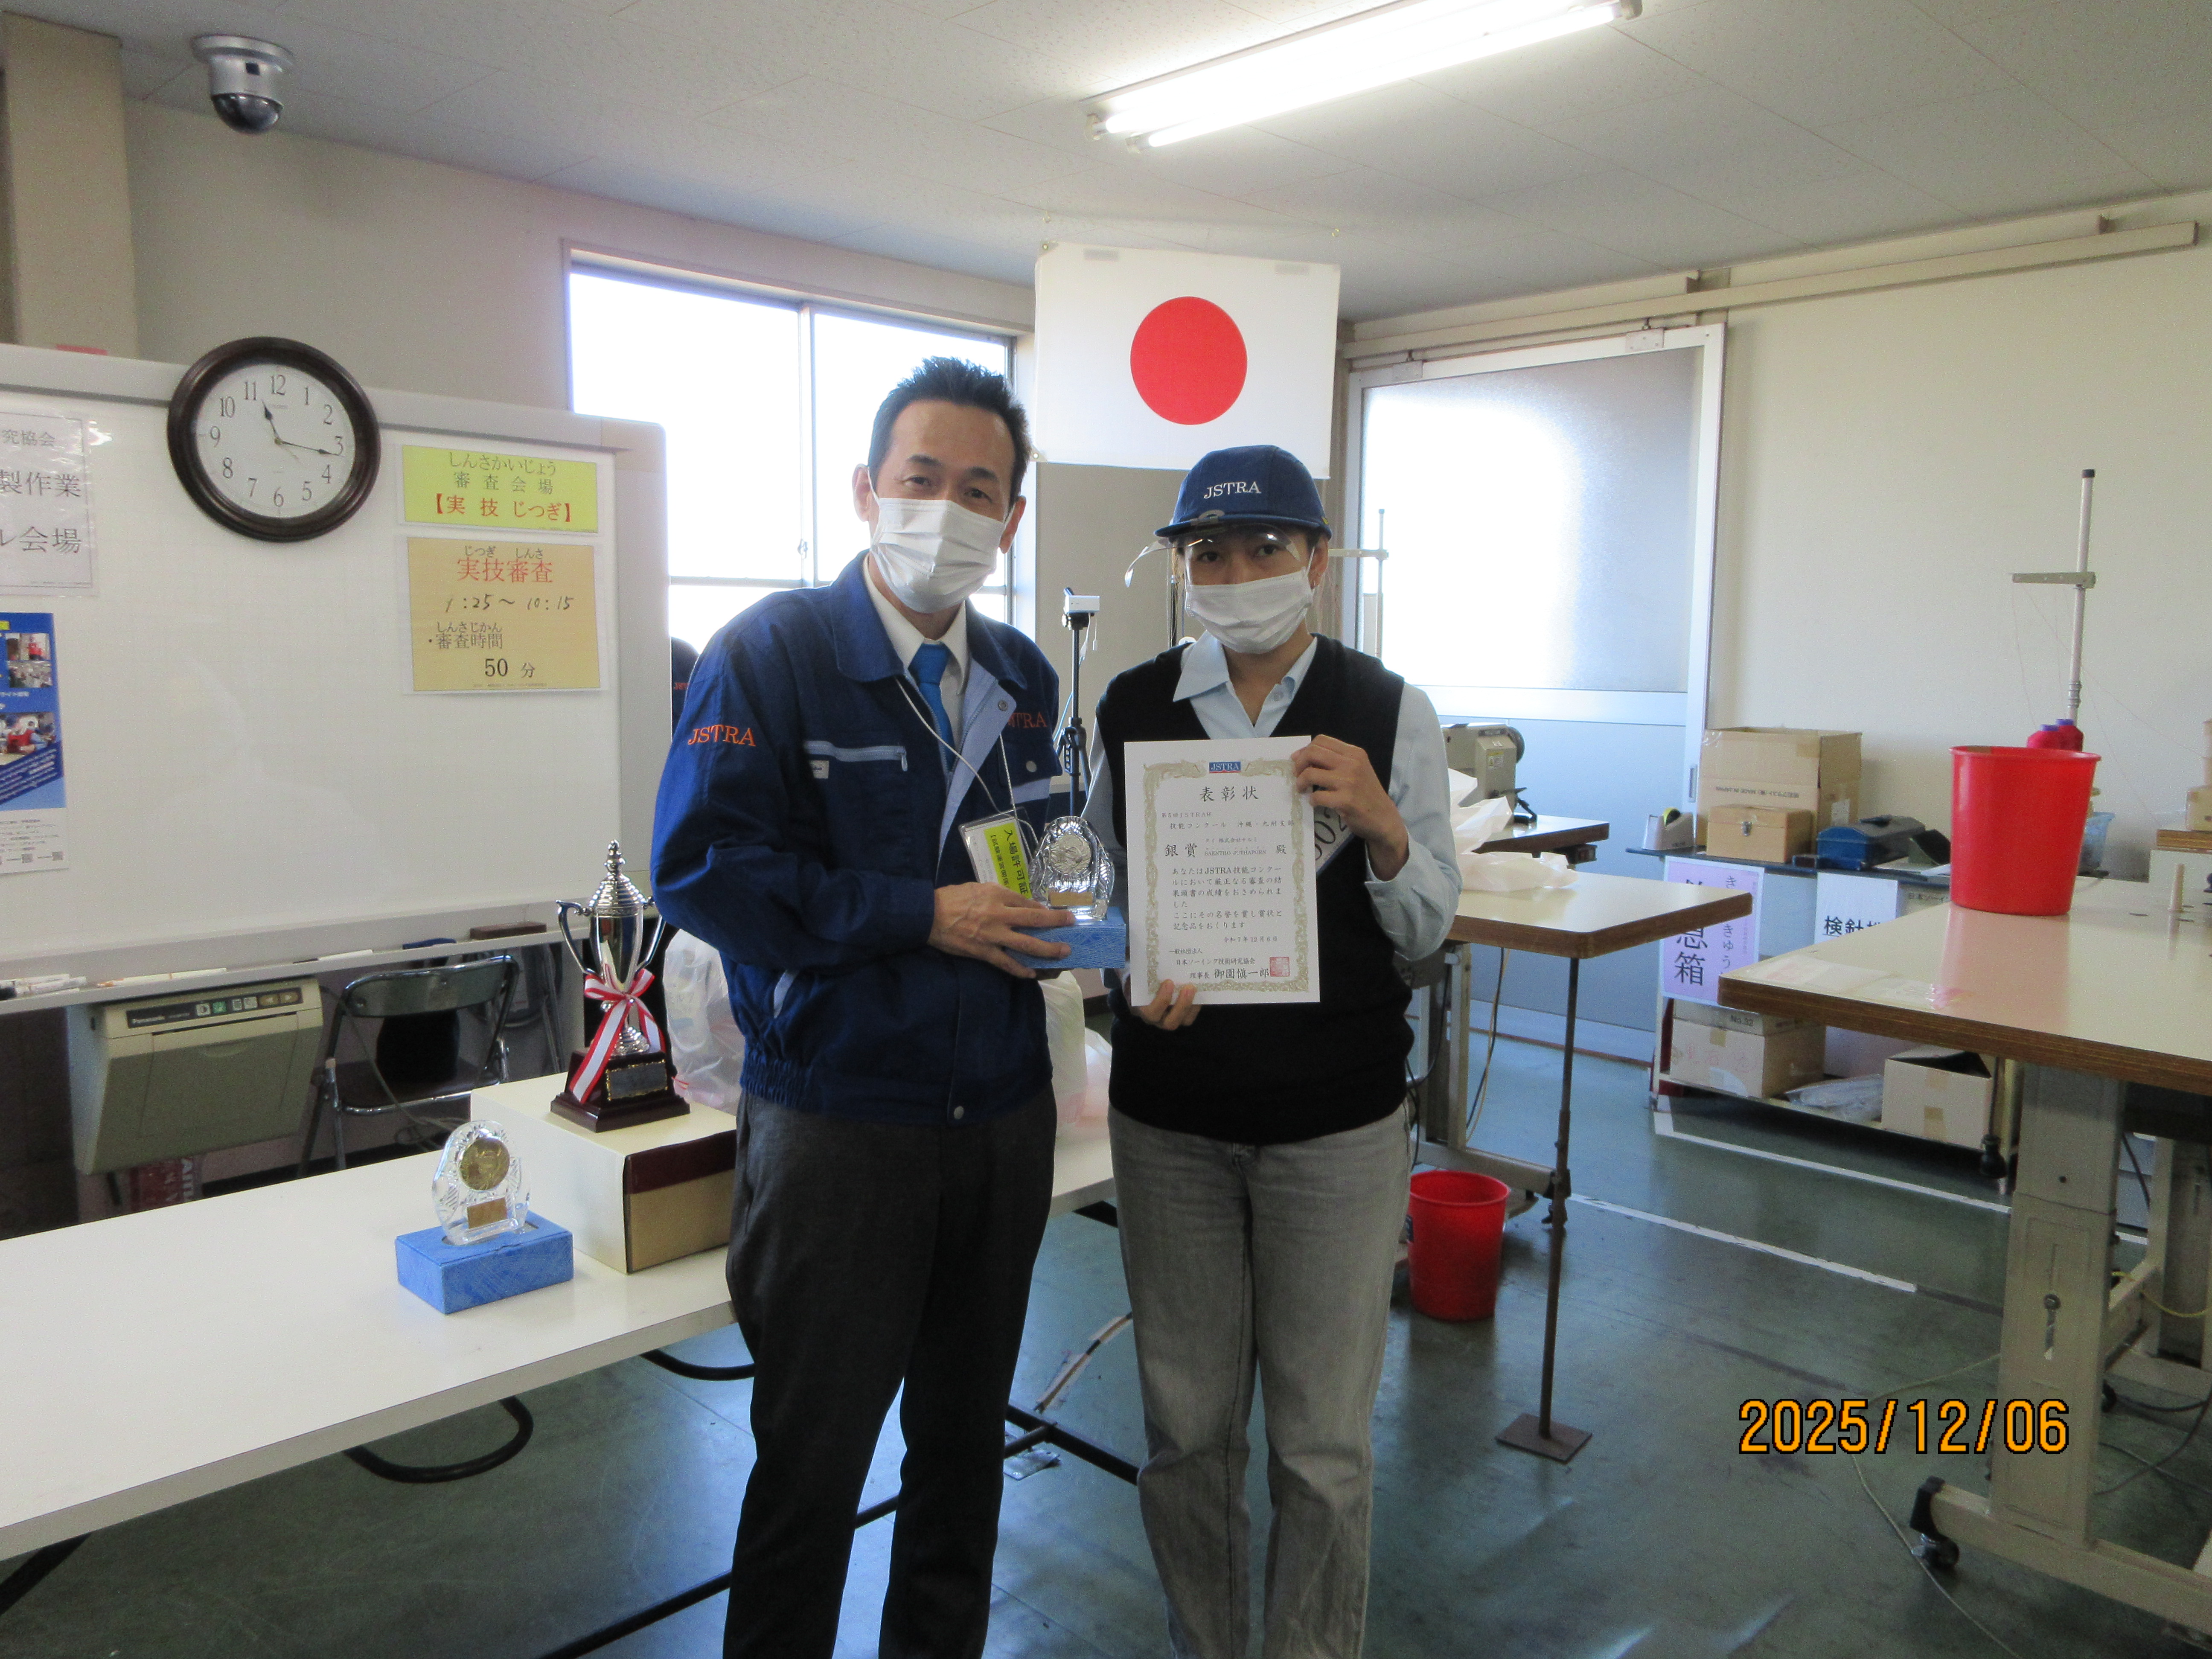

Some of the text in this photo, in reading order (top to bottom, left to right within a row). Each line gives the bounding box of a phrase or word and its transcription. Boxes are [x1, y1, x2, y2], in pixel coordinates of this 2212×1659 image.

[244, 381, 257, 401] 11
[271, 375, 286, 396] 12
[304, 386, 310, 405] 1
[219, 396, 235, 418] 10
[323, 404, 333, 425] 2
[210, 425, 221, 448] 9
[335, 436, 344, 457] 3
[222, 457, 234, 479] 8
[321, 464, 331, 484] 4
[449, 452, 556, 476] しんさかいじょう
[247, 477, 258, 498] 7
[273, 487, 284, 507] 6
[302, 480, 312, 501] 5
[1203, 481, 1262, 499] JSTRA
[464, 545, 544, 559] じつぎ しんさ
[457, 557, 553, 583] 実技審査
[485, 658, 536, 678] 50 分
[688, 724, 757, 747] JSTRA
[1211, 763, 1239, 771] JSTRA
[1199, 785, 1259, 802] 表彰状
[1164, 843, 1198, 858] 銀賞
